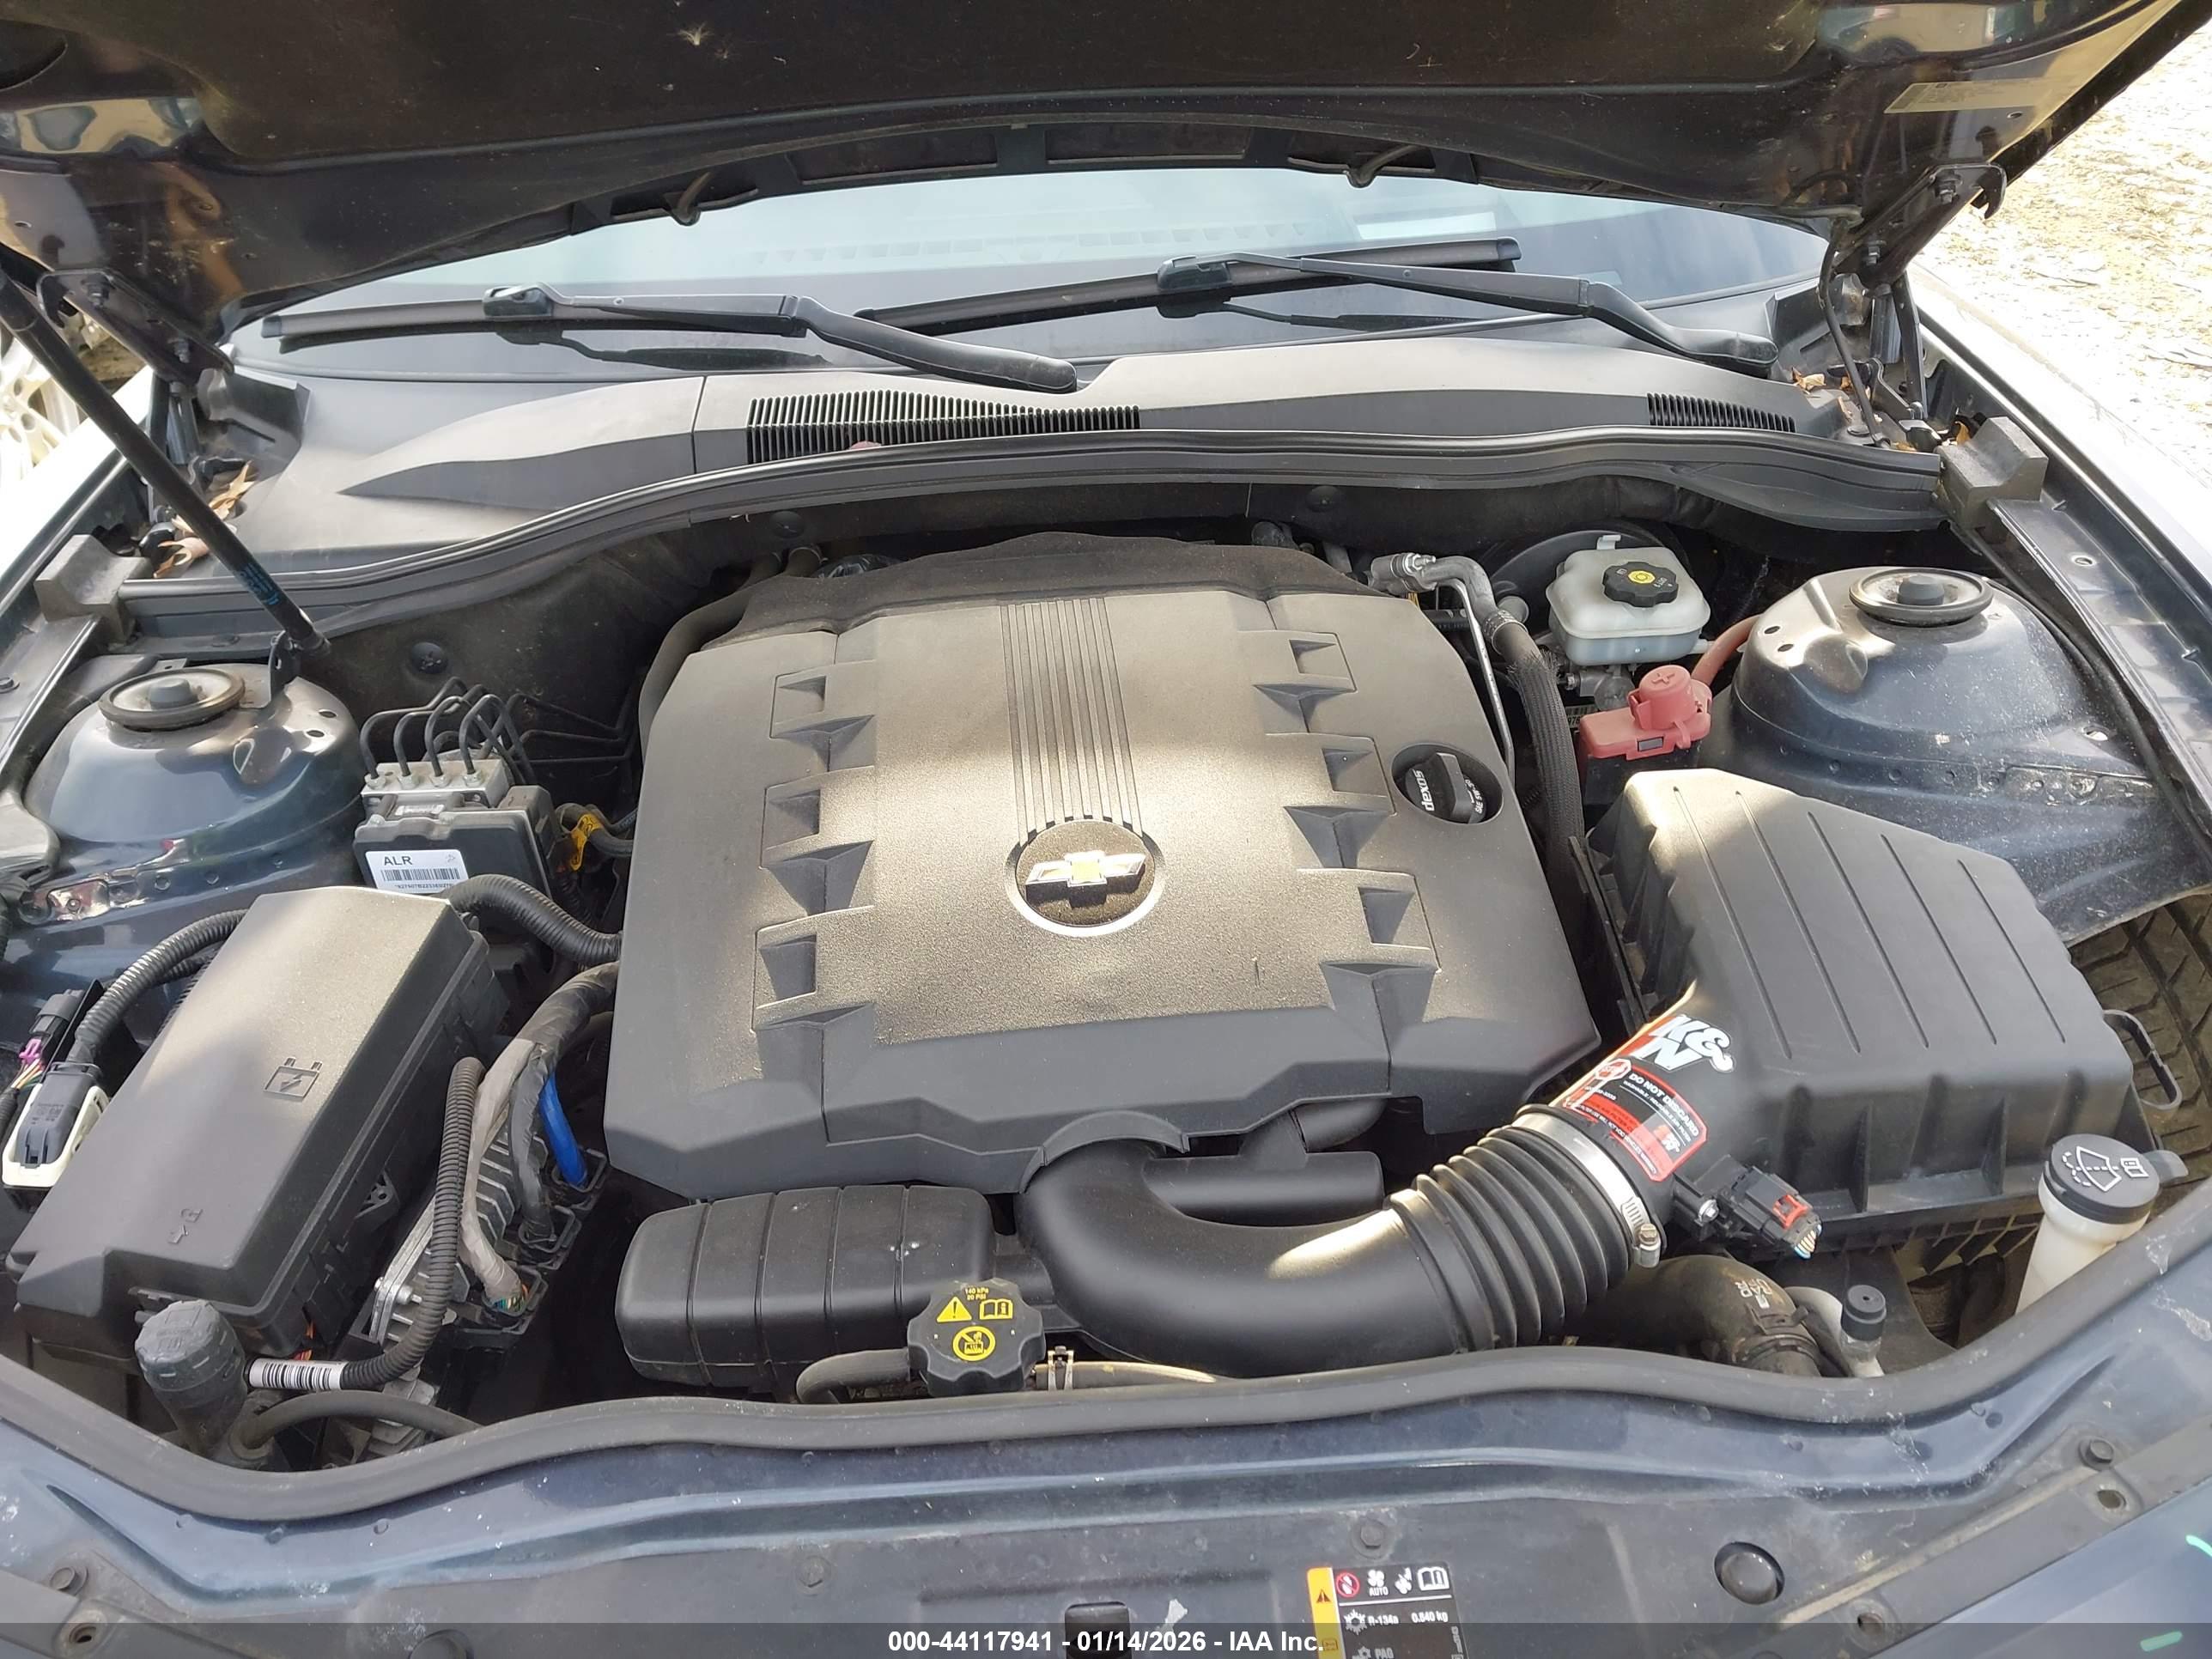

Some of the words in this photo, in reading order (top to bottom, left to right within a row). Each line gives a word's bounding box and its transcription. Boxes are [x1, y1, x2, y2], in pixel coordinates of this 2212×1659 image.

[1413, 769, 1435, 811] dexos
[384, 856, 412, 866] ALR
[1630, 1014, 1735, 1072] K&N
[1628, 1073, 1645, 1085] DO
[1643, 1080, 1666, 1098] NOT
[1662, 1095, 1699, 1137] DISCARD
[1369, 1586, 1389, 1596] AUTO
[1367, 1614, 1400, 1627] R-134a
[1436, 1610, 1449, 1623] kg
